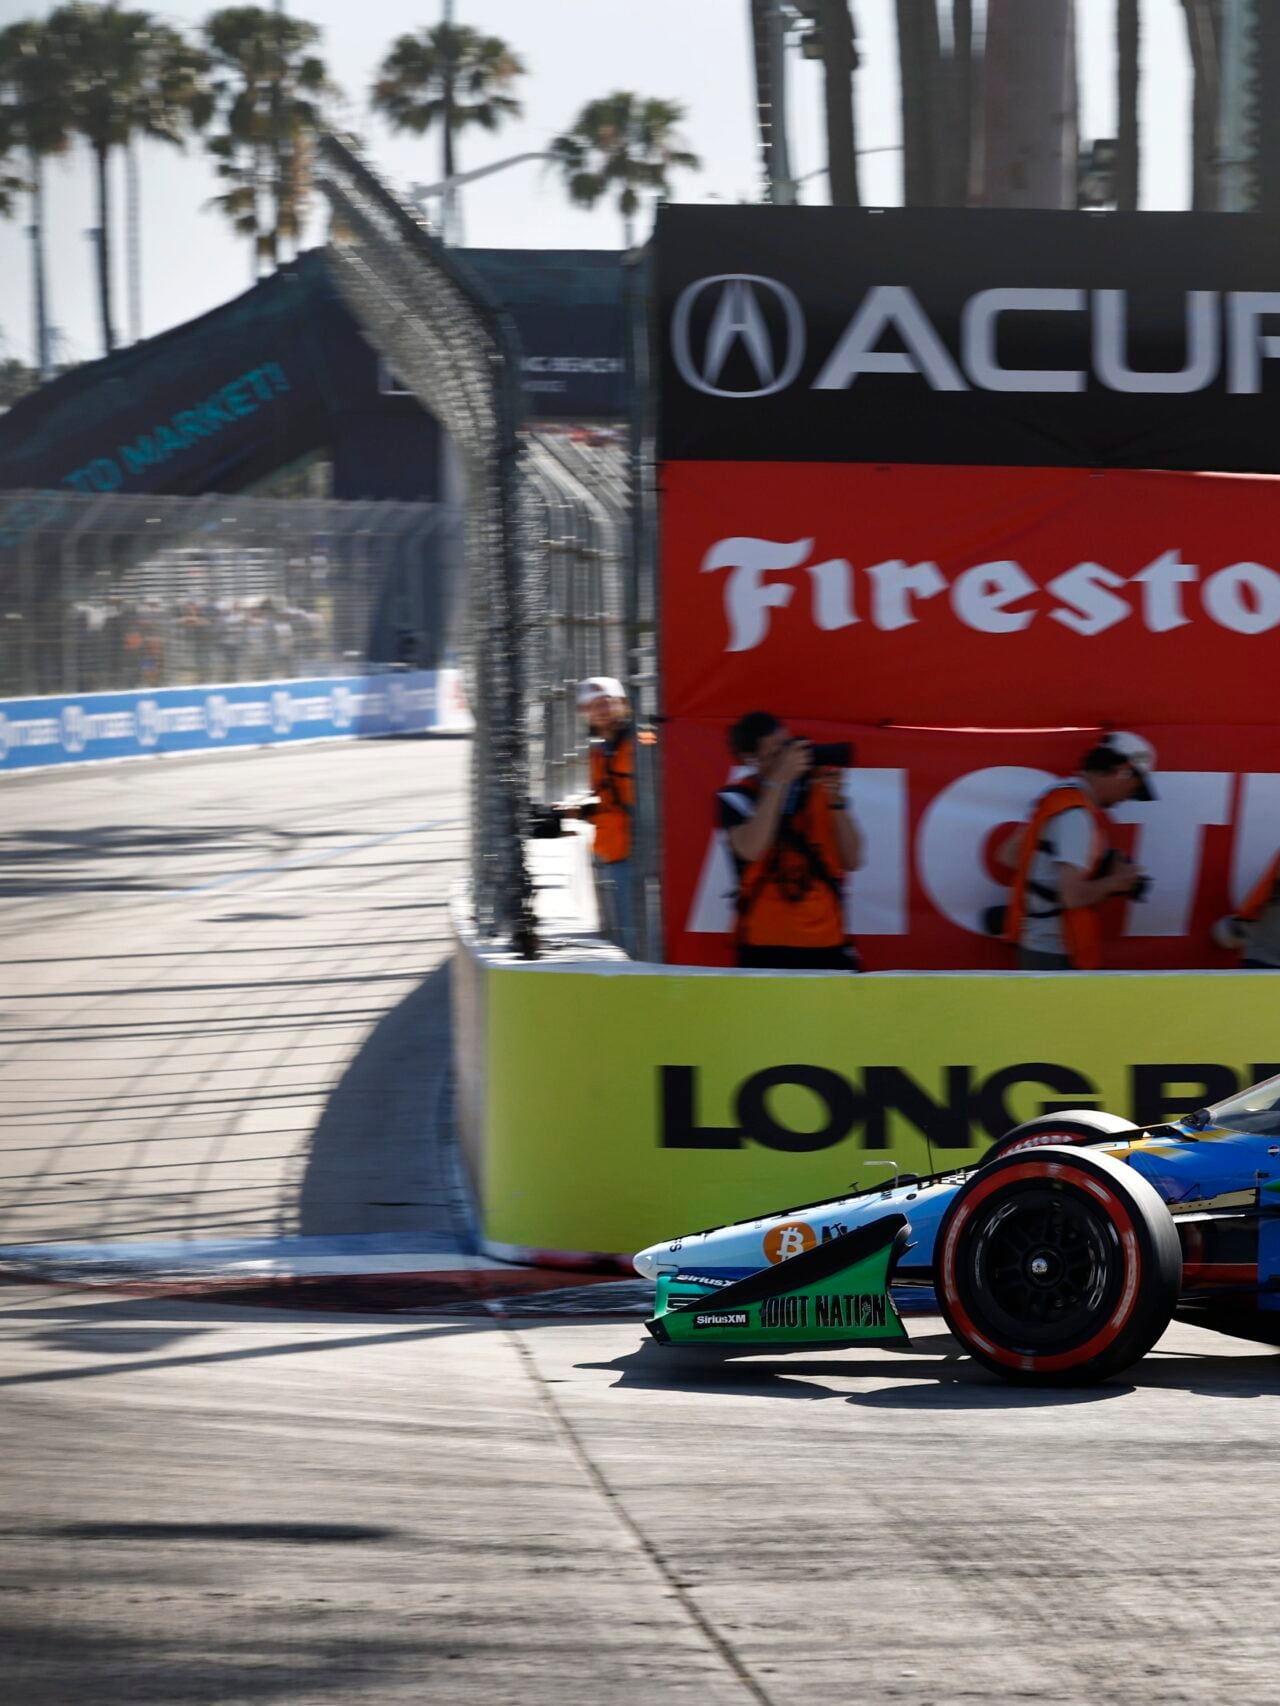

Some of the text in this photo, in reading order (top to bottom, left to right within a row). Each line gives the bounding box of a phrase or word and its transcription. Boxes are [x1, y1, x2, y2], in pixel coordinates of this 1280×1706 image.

[656, 1062, 1104, 1151] LONG
[676, 1273, 739, 1288] SiriusX
[696, 1314, 747, 1325] SiriusXM
[760, 1294, 887, 1329] IDIOT NATION
